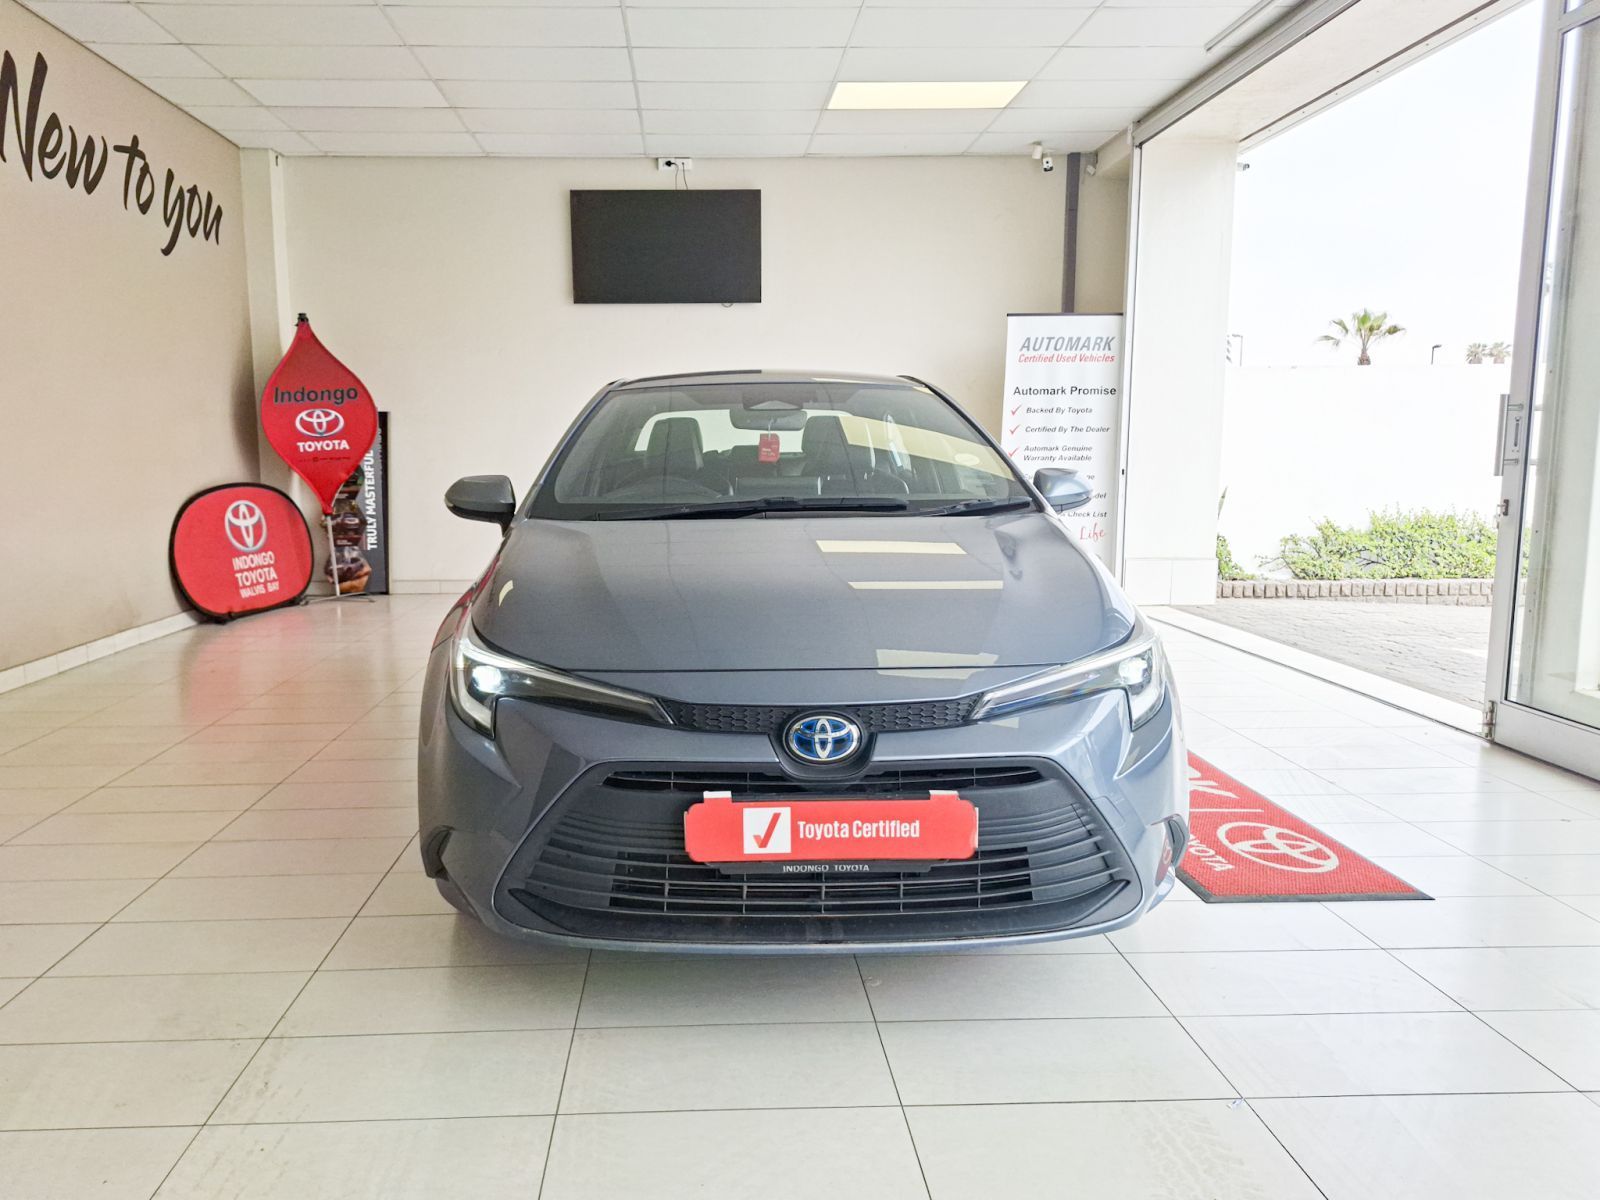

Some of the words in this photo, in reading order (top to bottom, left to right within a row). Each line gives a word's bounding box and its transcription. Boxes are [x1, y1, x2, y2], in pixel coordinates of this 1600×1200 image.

[0, 50, 108, 195] New
[113, 135, 155, 216] to
[160, 168, 223, 256] you
[1019, 336, 1116, 352] AUTOMARK
[1018, 353, 1053, 363] Certified
[1055, 353, 1077, 363] Used
[1078, 354, 1116, 363] Vehicles
[274, 386, 358, 406] Indongo
[1013, 386, 1067, 396] Automark
[1070, 386, 1117, 396] Promise
[1055, 407, 1065, 415] By
[1067, 407, 1093, 415] Toyota
[1058, 426, 1068, 434] By
[296, 440, 350, 453] TOYOTA
[1023, 454, 1056, 463] Warranty
[1058, 454, 1092, 462] Available
[363, 449, 377, 515] MASTERFUL
[366, 516, 378, 551] TRULY
[232, 551, 275, 571] INDONGO
[235, 567, 278, 587] TOYOTA
[798, 820, 849, 840] Toyota
[852, 819, 920, 838] Certified
[782, 864, 829, 873] INDONGO
[833, 864, 870, 872] TOYOTA
